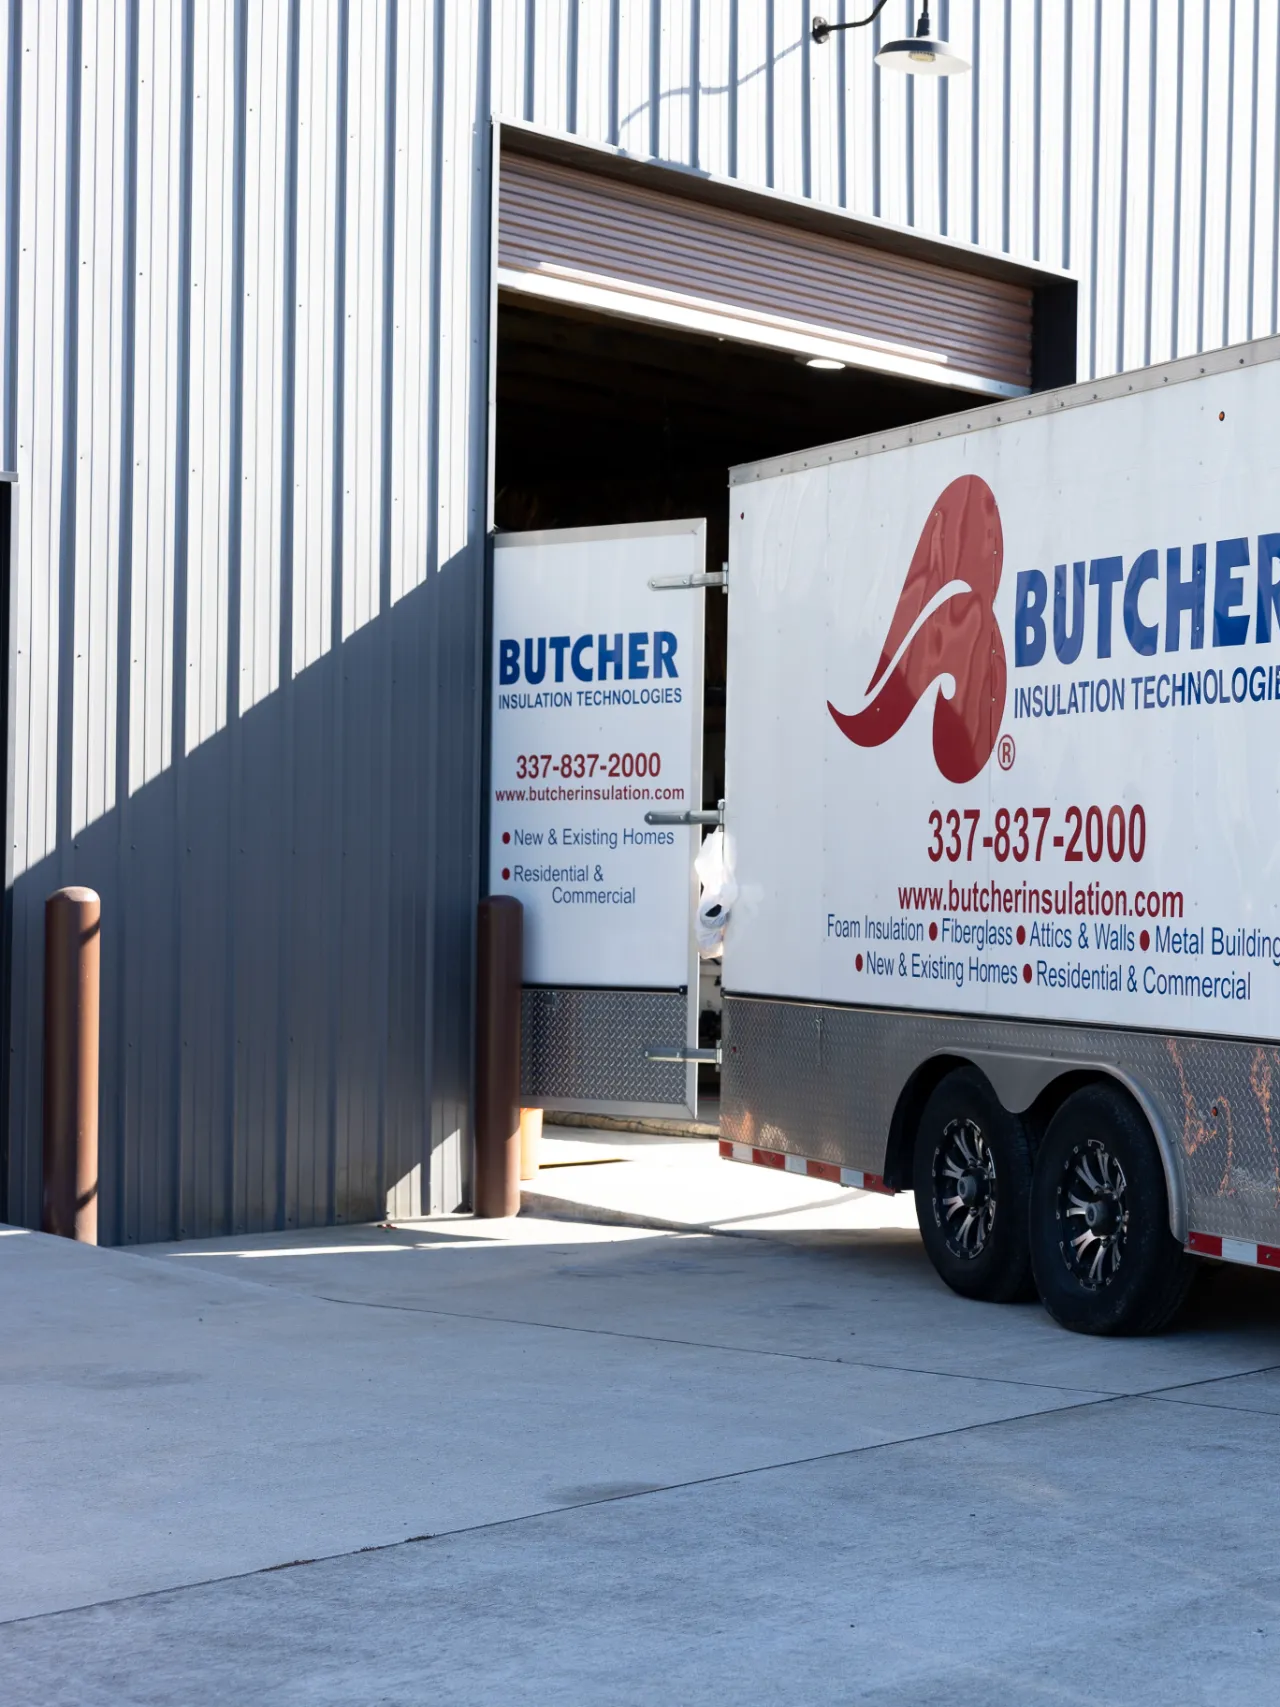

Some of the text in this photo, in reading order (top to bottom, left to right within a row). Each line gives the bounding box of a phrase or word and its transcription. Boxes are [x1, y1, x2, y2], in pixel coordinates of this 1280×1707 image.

[499, 630, 678, 686] BUTCHER
[499, 687, 681, 710] INSULATION TECHNOLOGIES
[1015, 678, 1124, 718] INSULATION
[516, 752, 660, 780] 337-837-2000
[495, 784, 684, 803] www.butcherinsulation.com
[515, 827, 674, 850] New & Existing Homes
[928, 804, 1145, 862] 337-837-2000
[514, 864, 603, 883] Residential &
[552, 886, 635, 904] Commercial
[898, 880, 1183, 919] www.butcherinsulation.com
[828, 914, 860, 937] Foam
[865, 916, 923, 941] Insulation
[942, 918, 1012, 950] Fiberglass
[1030, 921, 1072, 948] Attics
[1078, 923, 1089, 949] &
[1095, 923, 1134, 951] Walls
[1156, 925, 1203, 954] Metal
[867, 950, 1250, 1001] New & Existing Homes Residential & Commercial
